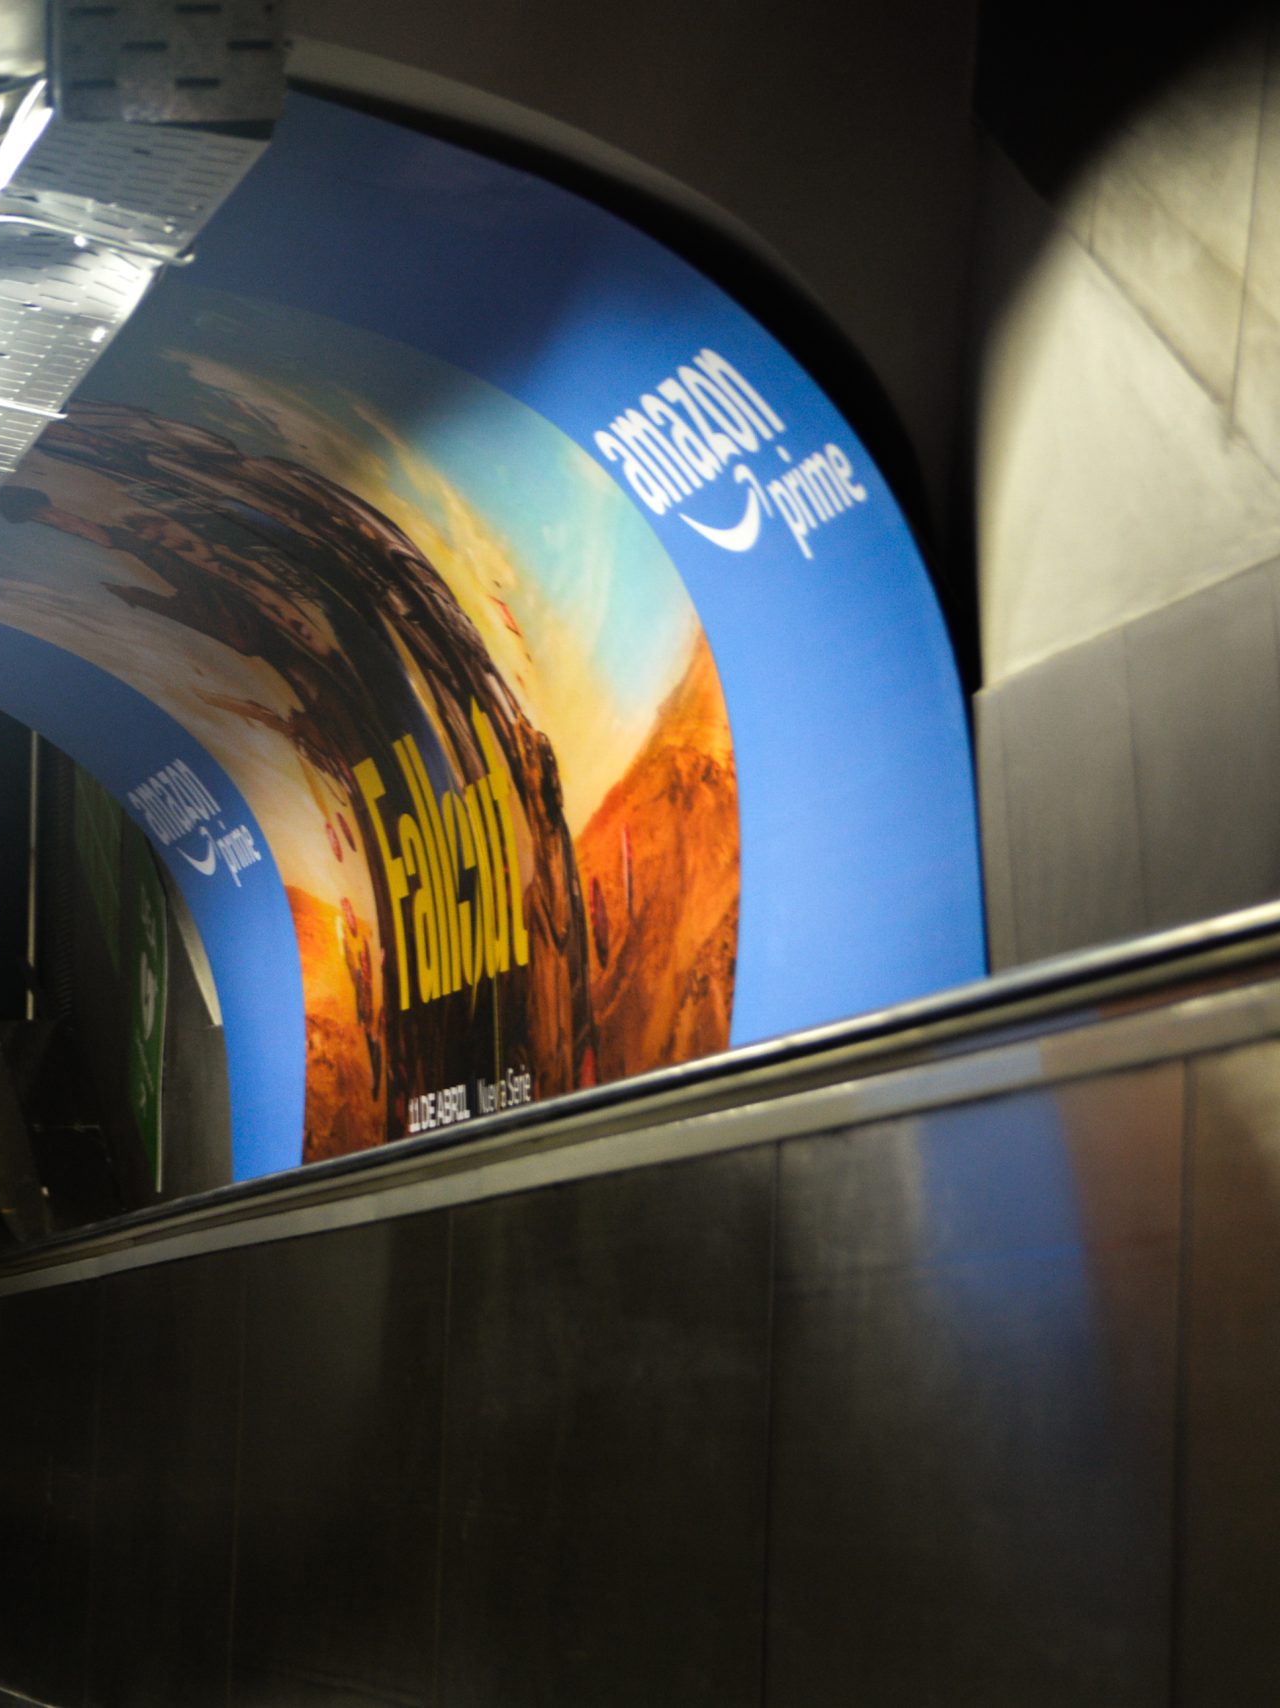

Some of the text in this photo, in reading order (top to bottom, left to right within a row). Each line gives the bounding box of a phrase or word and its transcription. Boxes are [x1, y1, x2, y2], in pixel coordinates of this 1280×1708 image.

[593, 348, 787, 516] amazon
[767, 443, 869, 560] prime
[127, 758, 221, 846] amazon
[217, 820, 262, 887] prime
[352, 696, 529, 1011] Fallout
[420, 1092, 437, 1130] DE
[436, 1084, 471, 1127] ABRIL
[507, 1064, 531, 1105] Serie
